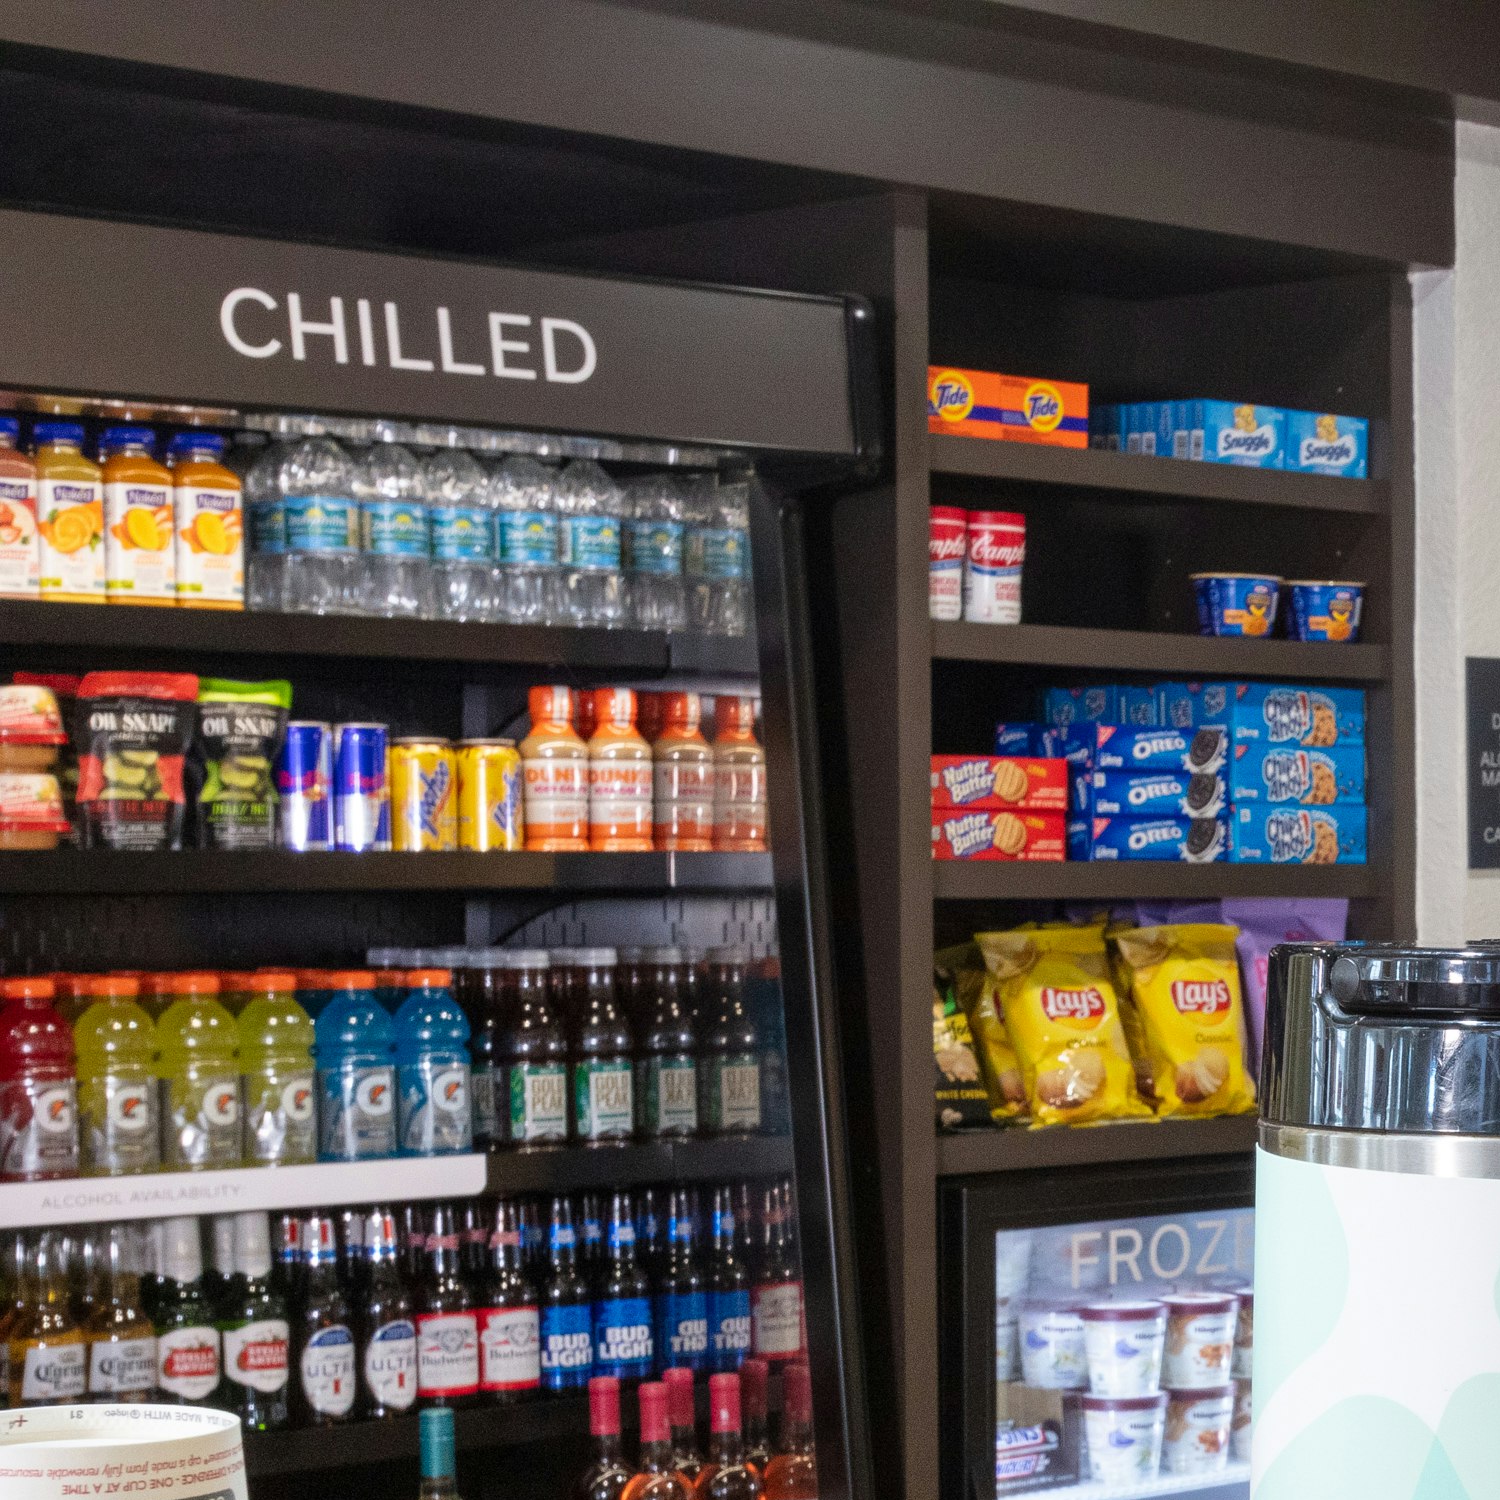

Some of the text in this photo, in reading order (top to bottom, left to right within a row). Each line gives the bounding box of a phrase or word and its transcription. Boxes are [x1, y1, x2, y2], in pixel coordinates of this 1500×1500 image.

[220, 286, 598, 385] CHILLED
[937, 384, 969, 409] Tide
[1029, 396, 1059, 419] Tide
[1223, 433, 1270, 454] Snuggle
[1304, 442, 1350, 463] Snuggle
[1132, 737, 1186, 760] OREO
[943, 761, 990, 787] Nutter
[952, 774, 995, 804] Butter
[1128, 781, 1182, 805] OREO
[944, 814, 990, 842] Nutter
[1128, 826, 1182, 850] OREO
[953, 826, 995, 857] Butter
[283, 1079, 313, 1121] G
[356, 1073, 392, 1116] G
[433, 1071, 466, 1112] G
[33, 1089, 70, 1133] G
[111, 1086, 147, 1130] G
[203, 1082, 237, 1125] G
[42, 1184, 241, 1210] ALCOHOL AVAILABILITY
[549, 1333, 590, 1350] BUD
[606, 1325, 651, 1343] BUD
[541, 1348, 593, 1368] LIGHT
[600, 1340, 653, 1360] LIGHT
[144, 1410, 173, 1420] WITH
[47, 1466, 101, 1479] renewable
[102, 1463, 124, 1476] fully
[126, 1461, 149, 1475] from
[152, 1461, 177, 1472] made
[62, 1483, 90, 1495] TIME
[93, 1482, 102, 1494] A
[106, 1482, 119, 1493] AT
[124, 1480, 147, 1492] CUP
[150, 1477, 174, 1489] ONE
